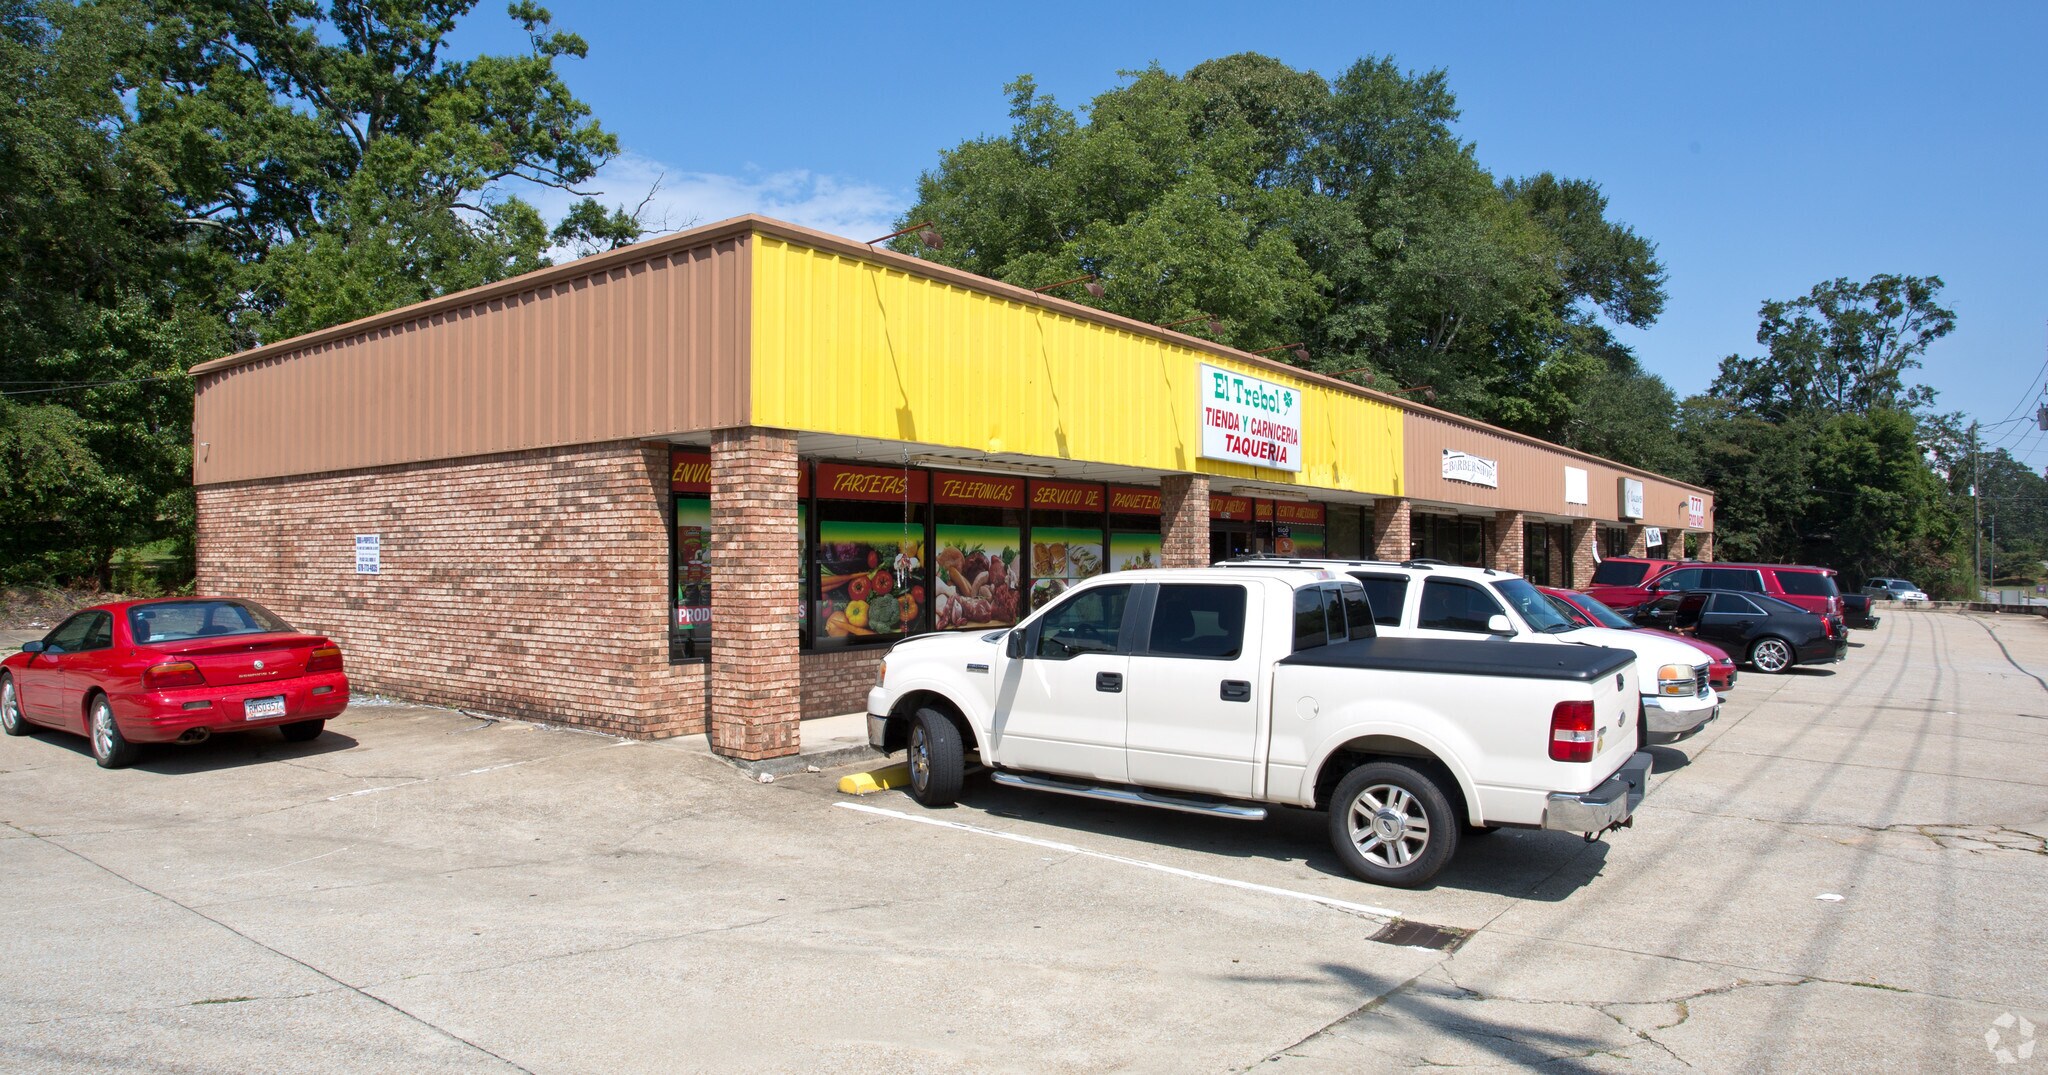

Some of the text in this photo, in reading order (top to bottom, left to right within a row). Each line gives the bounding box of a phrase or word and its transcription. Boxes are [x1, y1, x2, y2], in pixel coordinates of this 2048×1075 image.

[1213, 372, 1280, 414] El Trebol
[1205, 406, 1298, 446] TIENDA Y CARNICERIA
[1225, 433, 1287, 464] TAQUERIA
[832, 472, 907, 494] TARJETAS
[941, 479, 1015, 502] TELEFONICAS
[1033, 487, 1099, 506] SERVICIO DE
[1112, 492, 1162, 509] PAQUETERI
[1691, 496, 1701, 512] 777
[678, 607, 712, 623] PROD
